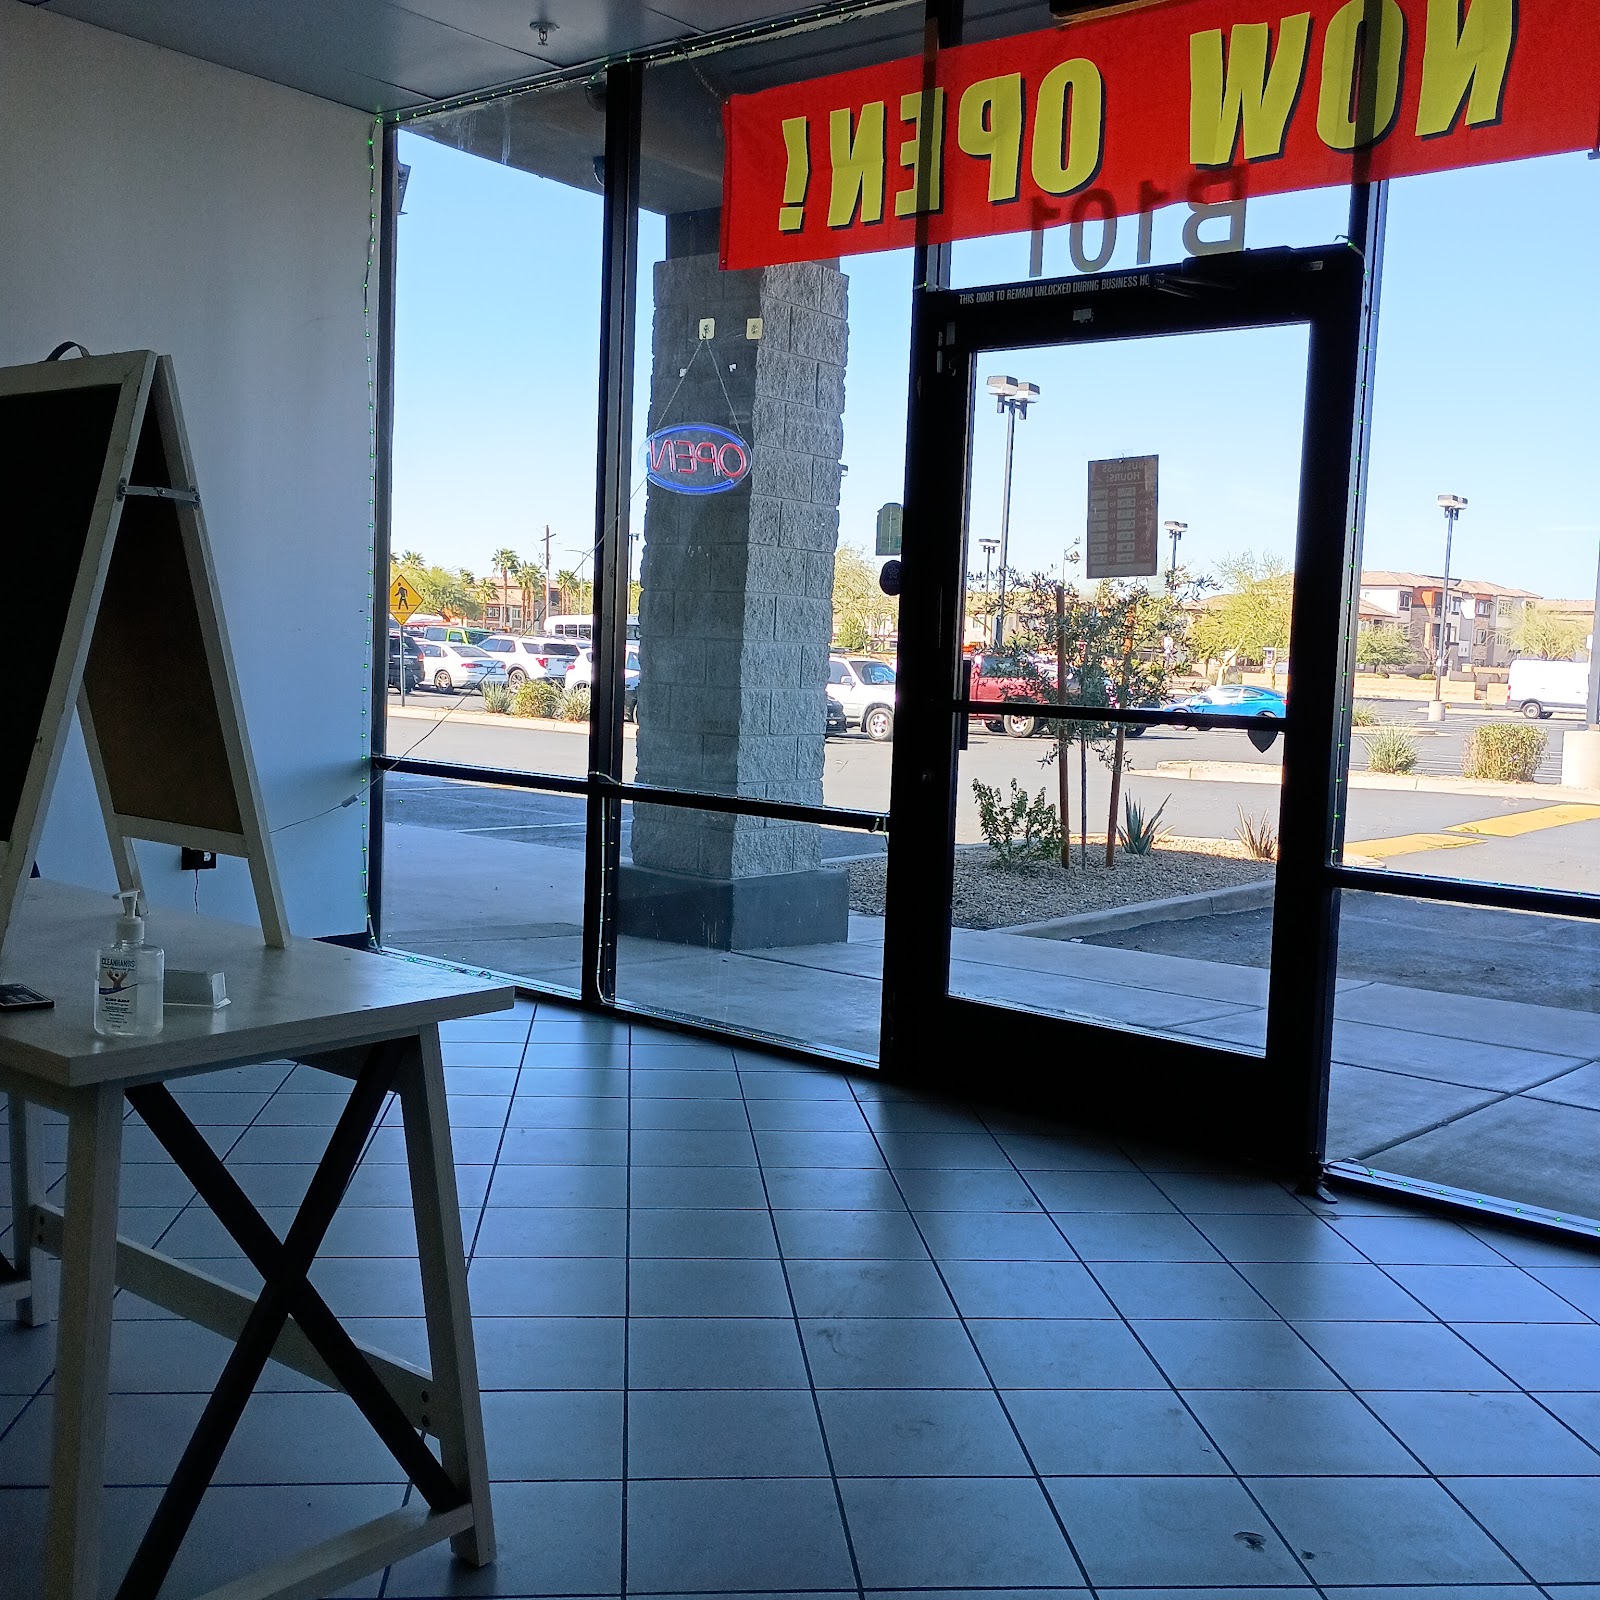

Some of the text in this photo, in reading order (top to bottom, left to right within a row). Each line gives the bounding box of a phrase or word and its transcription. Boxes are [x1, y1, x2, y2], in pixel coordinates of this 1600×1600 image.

[959, 294, 974, 305] THIS
[976, 291, 994, 303] DOOR
[996, 290, 1006, 301] TO
[1006, 286, 1034, 300] REMAIN
[1034, 282, 1071, 298] UNLOCKED
[1072, 279, 1100, 294] DURING
[1101, 275, 1138, 290] BUSINESS
